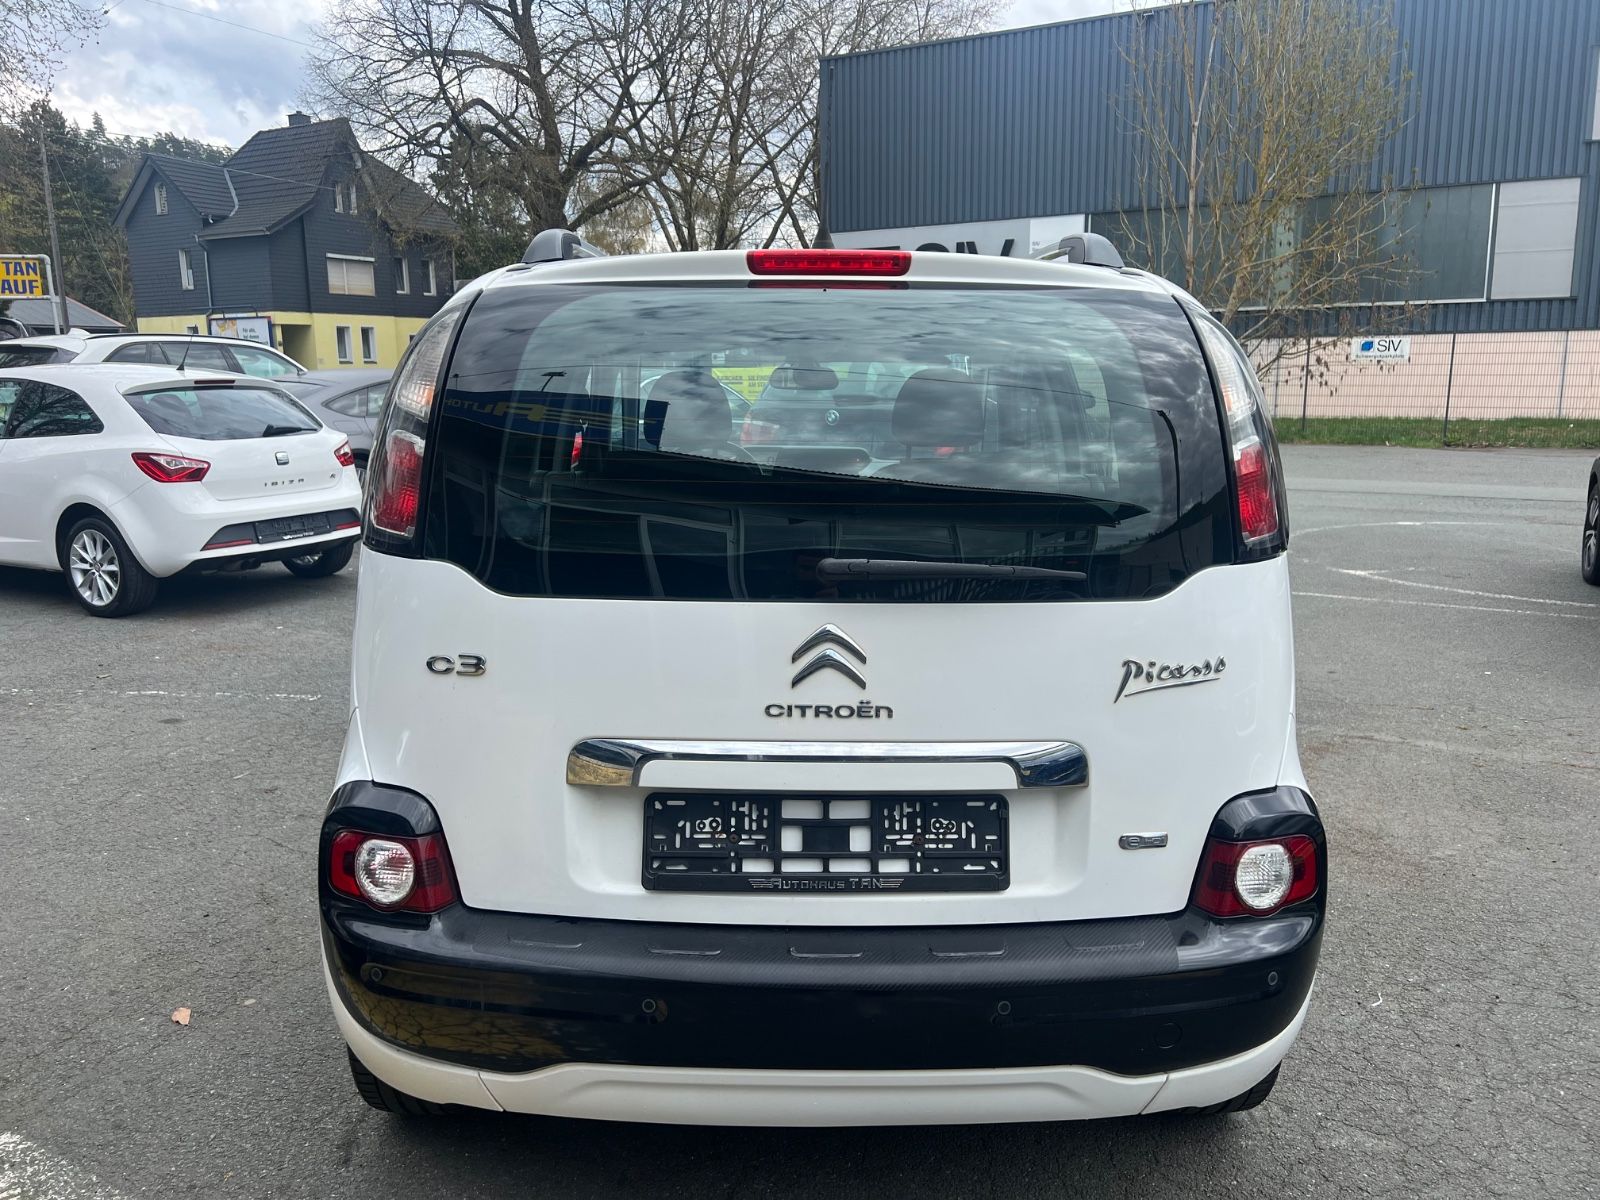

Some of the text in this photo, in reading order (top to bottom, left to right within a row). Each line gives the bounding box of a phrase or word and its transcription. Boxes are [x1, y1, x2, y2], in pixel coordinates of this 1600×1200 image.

[1, 261, 38, 276] TAN
[1377, 339, 1402, 352] SIV
[264, 478, 304, 487] IBIZA
[426, 654, 487, 676] C3
[1113, 656, 1226, 703] Picasso
[849, 878, 882, 889] TAN
